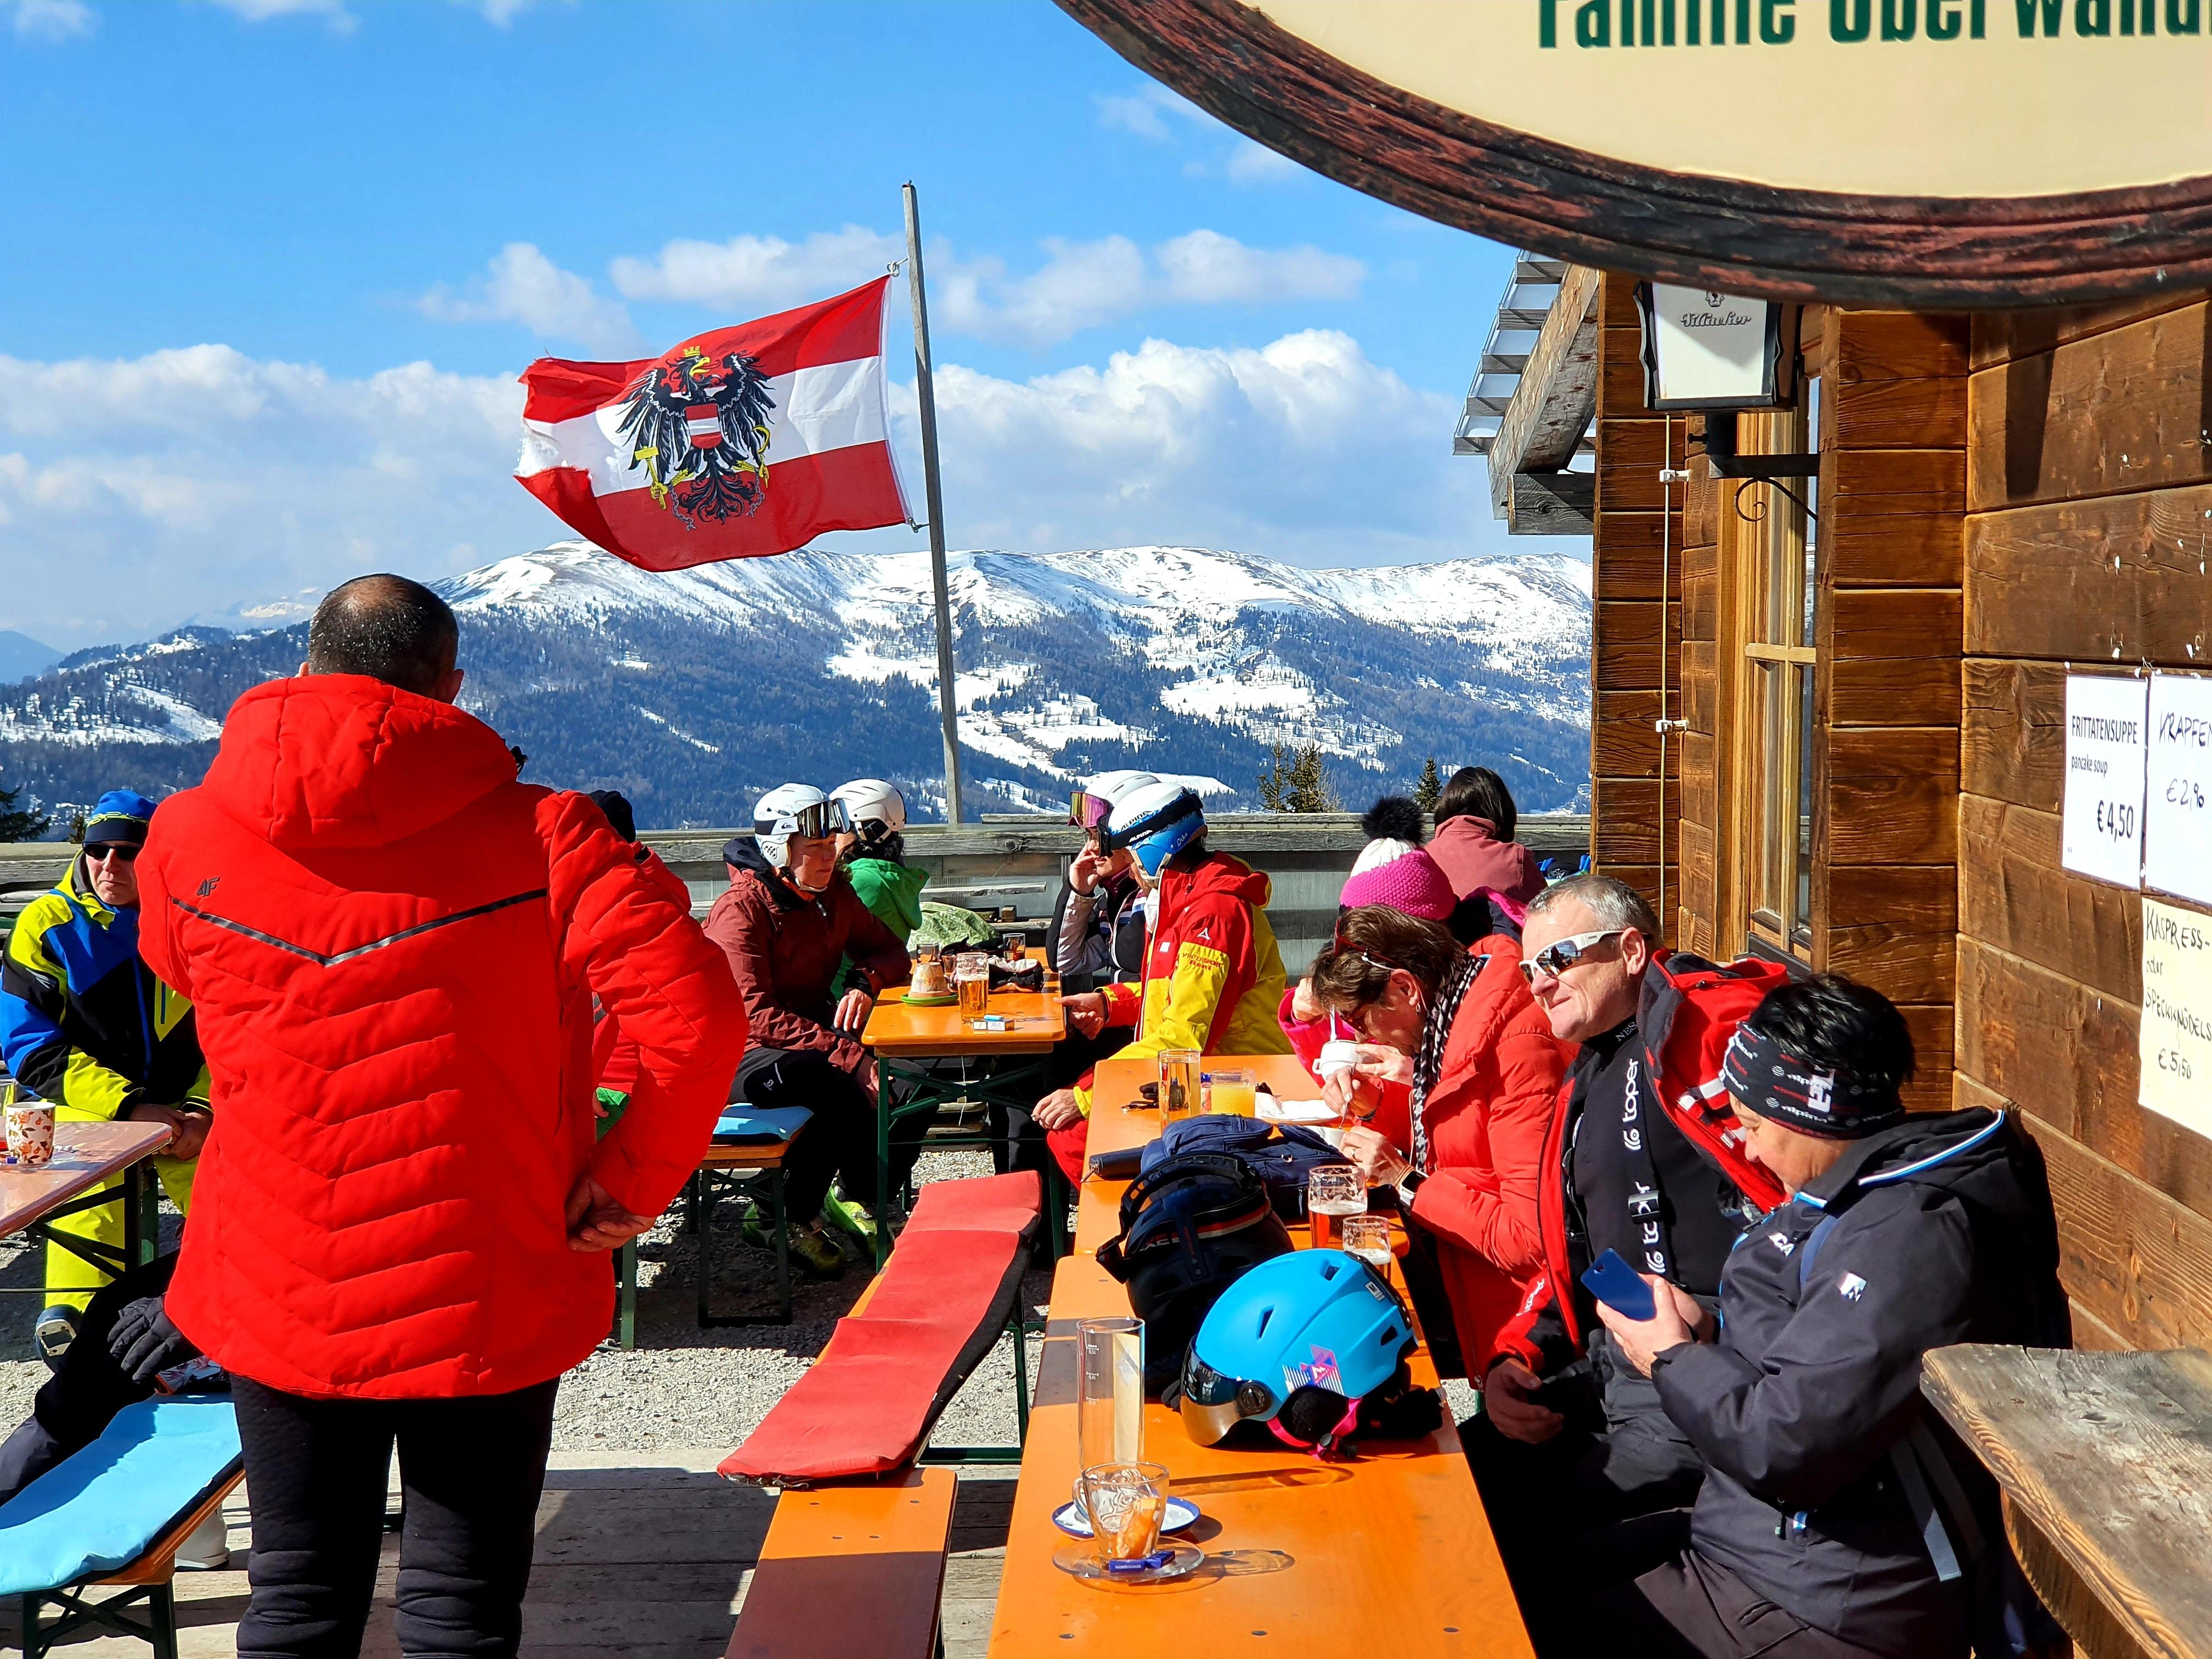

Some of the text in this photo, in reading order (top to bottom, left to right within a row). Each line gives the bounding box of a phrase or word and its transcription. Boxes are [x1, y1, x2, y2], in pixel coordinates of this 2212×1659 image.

[2072, 715, 2138, 744] FRITTATENSUPPE
[2071, 753, 2108, 778] pancake soup
[1622, 1058, 1639, 1122] toper
